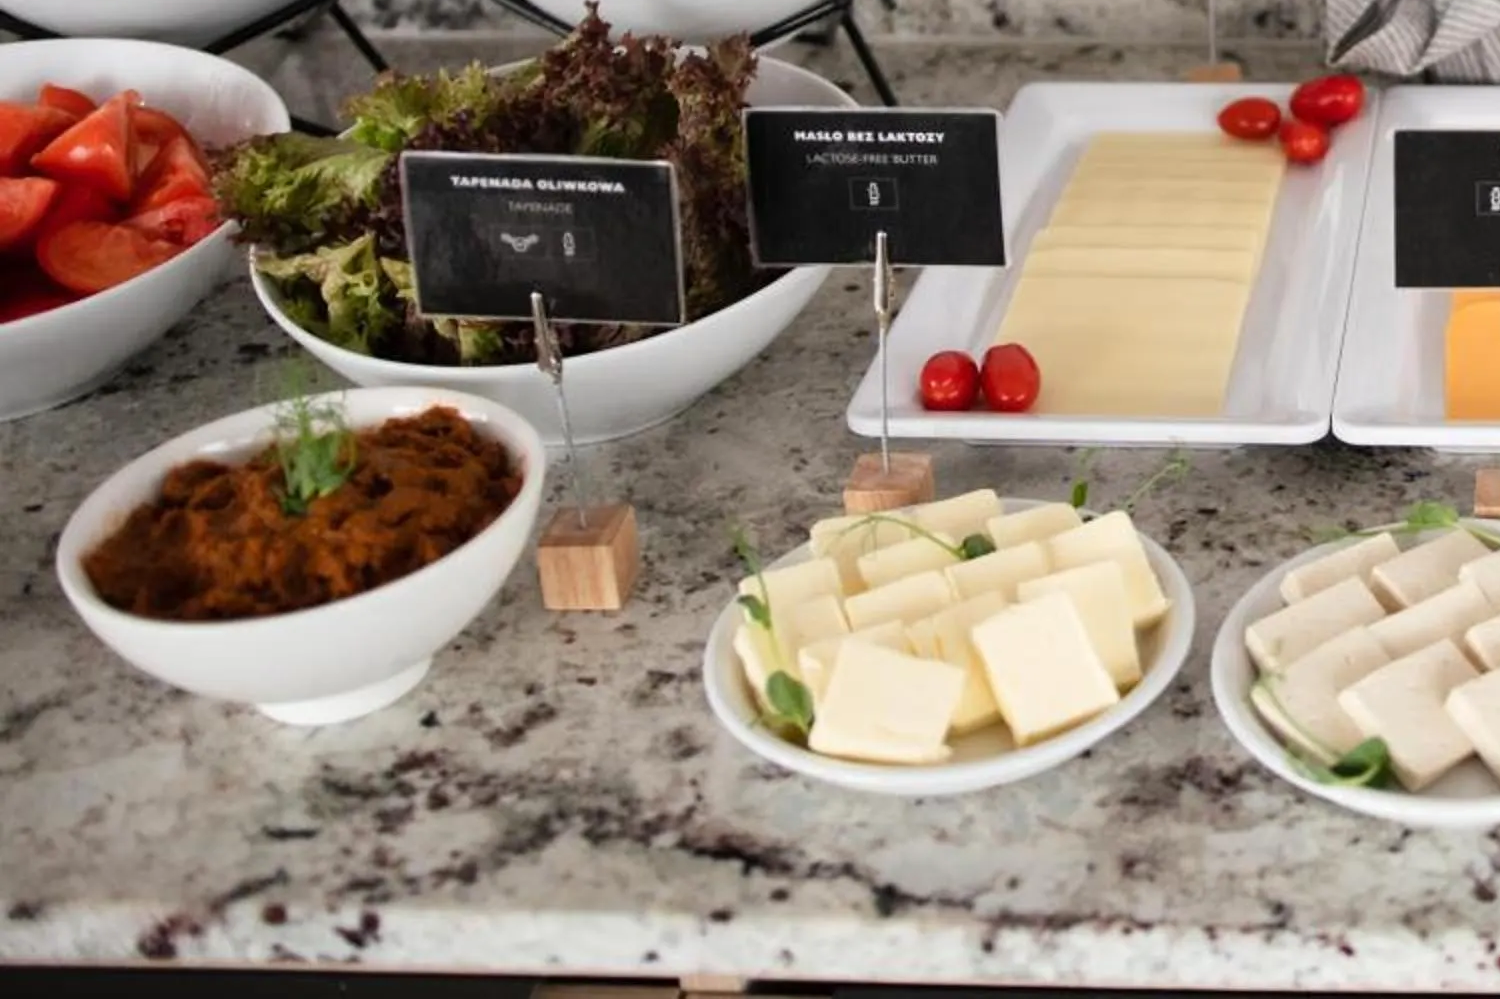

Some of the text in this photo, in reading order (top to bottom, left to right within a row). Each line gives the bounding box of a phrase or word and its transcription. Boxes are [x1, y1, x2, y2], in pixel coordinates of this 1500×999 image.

[793, 130, 945, 143] MASŁO BEZ LAKTOZY
[893, 153, 938, 165] BUTTER
[450, 175, 626, 193] TAPENADA OLIWKOWA
[508, 201, 574, 214] TAPENADE
